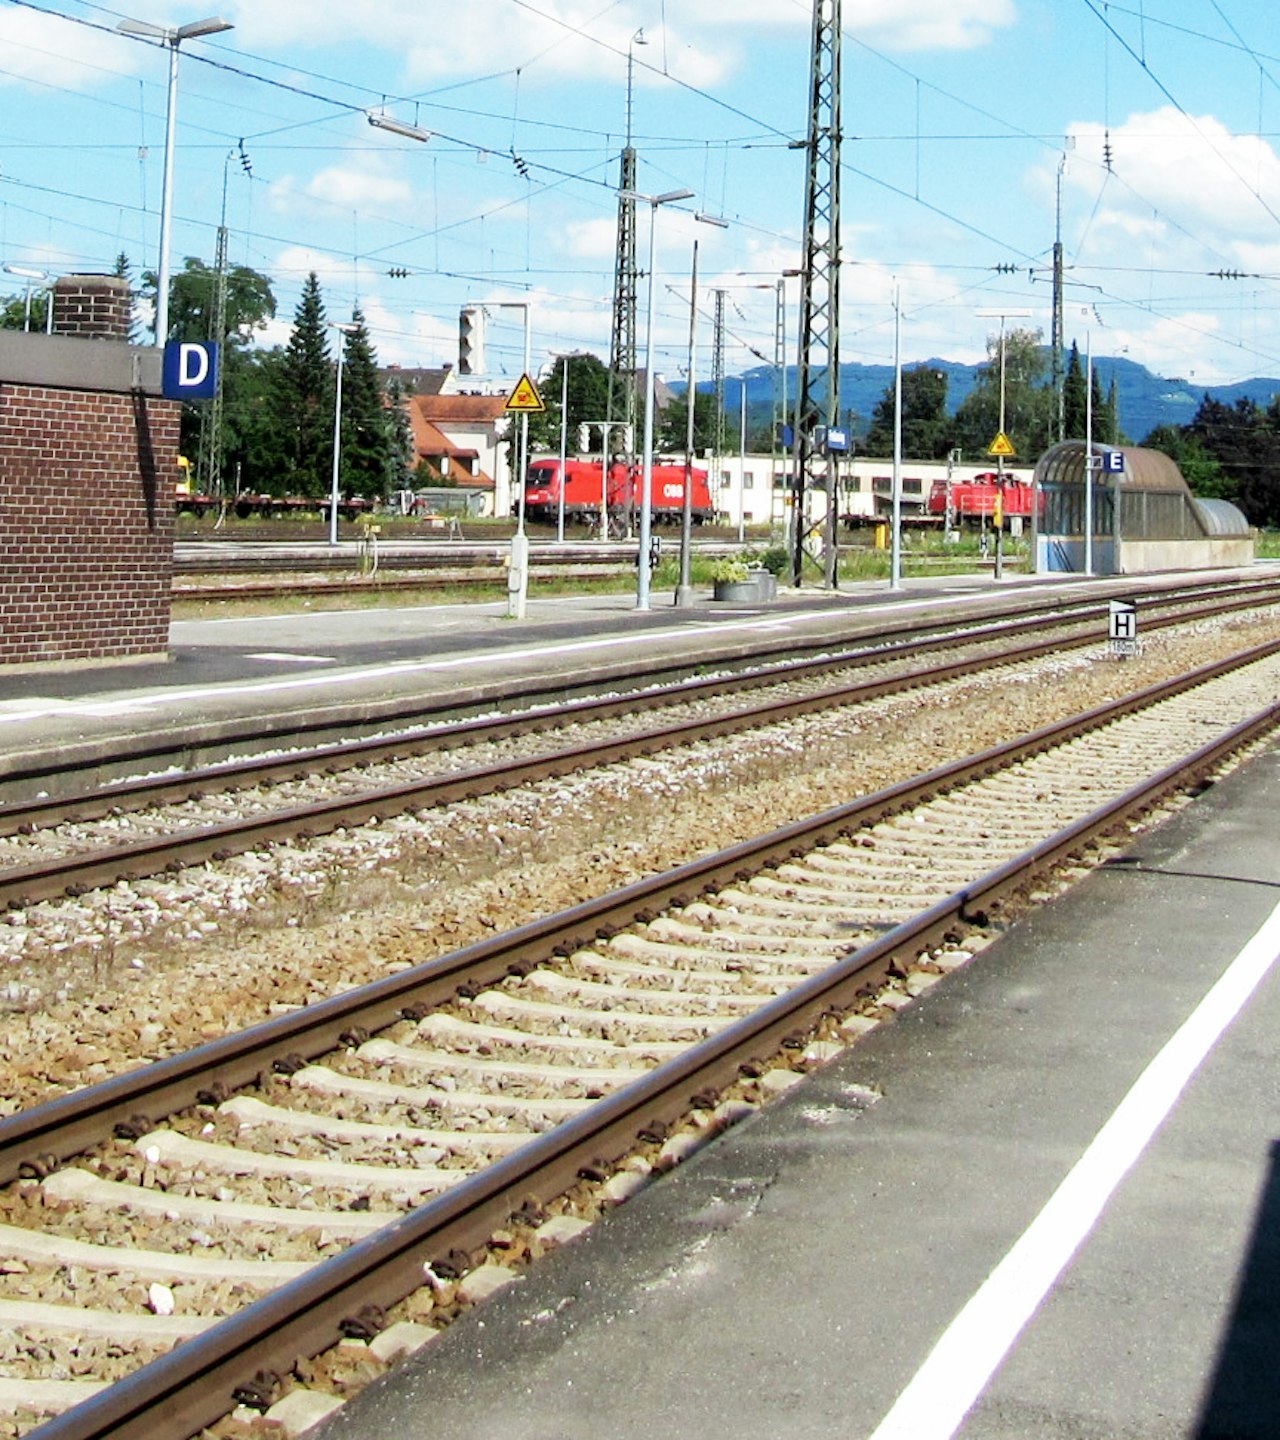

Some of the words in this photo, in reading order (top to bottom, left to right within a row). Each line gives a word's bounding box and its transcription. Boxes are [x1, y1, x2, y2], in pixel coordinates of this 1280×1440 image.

[179, 343, 209, 386] D
[1110, 452, 1122, 470] E
[651, 537, 660, 552] H
[1115, 614, 1129, 636] H
